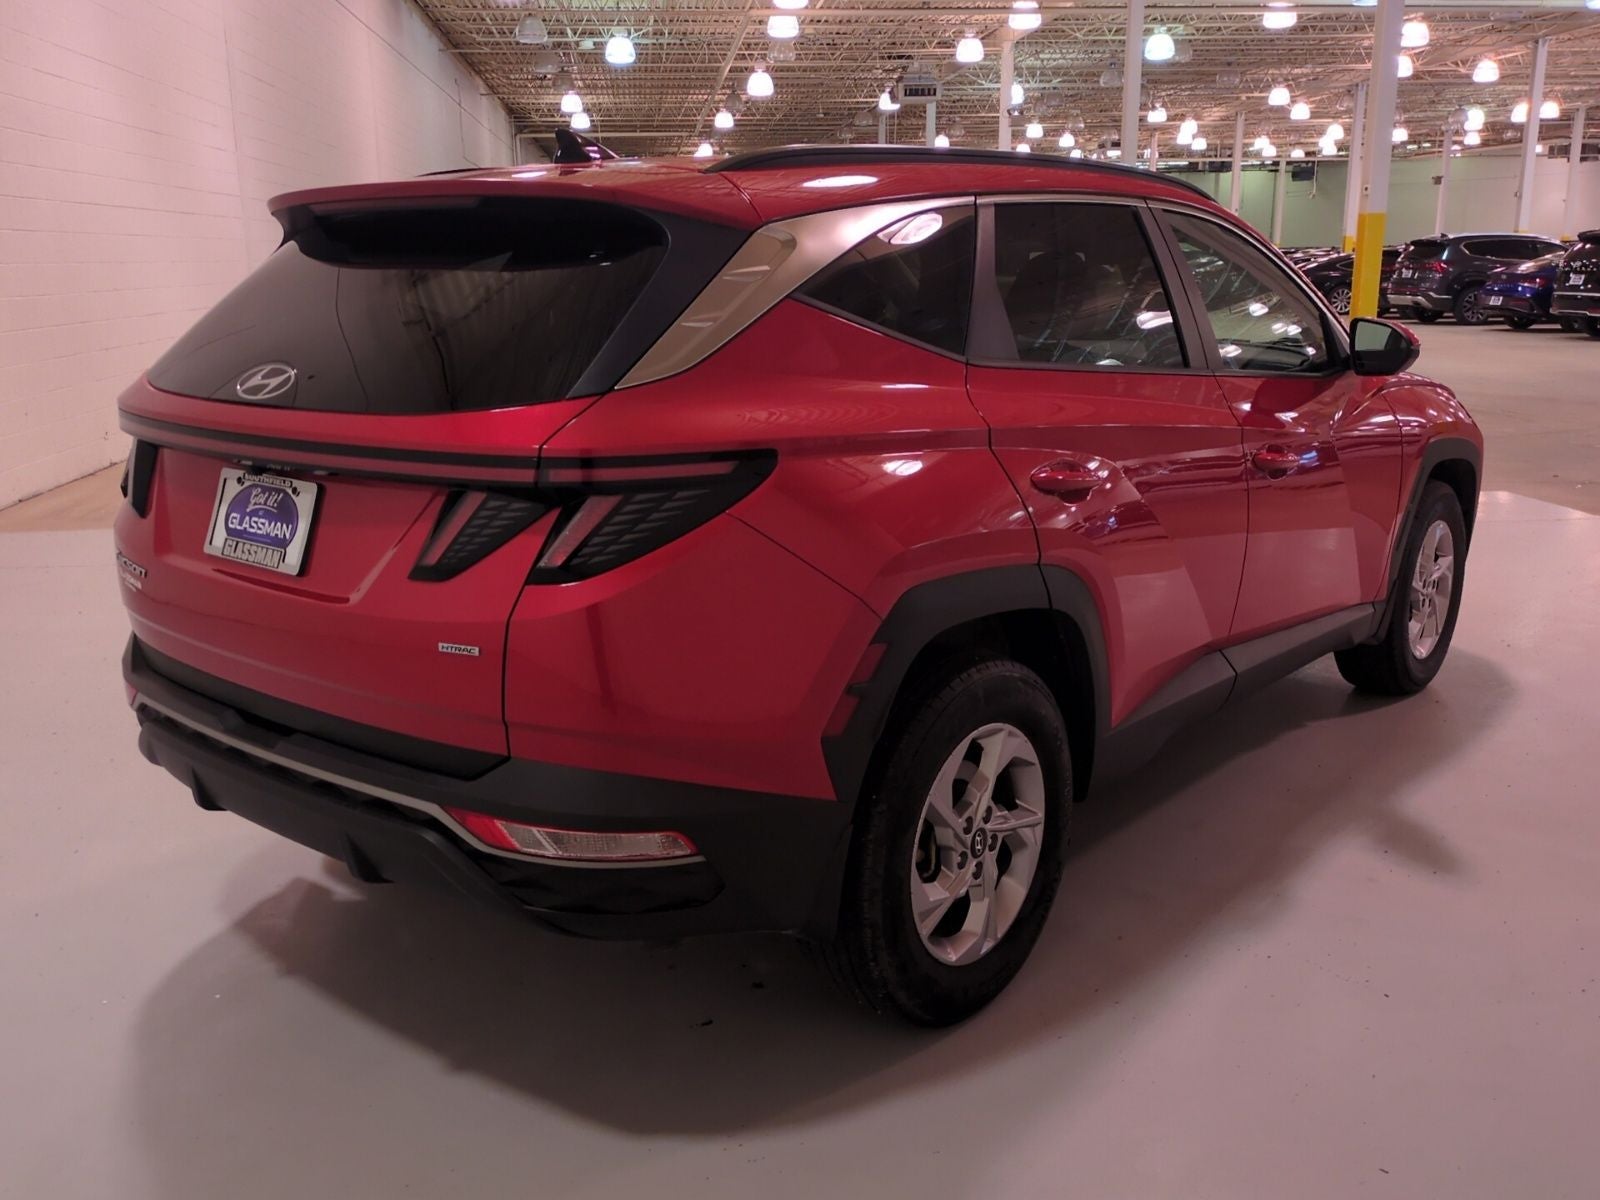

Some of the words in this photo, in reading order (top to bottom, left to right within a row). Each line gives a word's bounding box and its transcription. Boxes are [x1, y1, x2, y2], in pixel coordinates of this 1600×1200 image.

[250, 487, 269, 507] Got
[269, 491, 284, 508] it!
[228, 512, 292, 540] GLASSMAN
[223, 539, 281, 569] GLASSMAN
[441, 644, 477, 655] HTRAC
